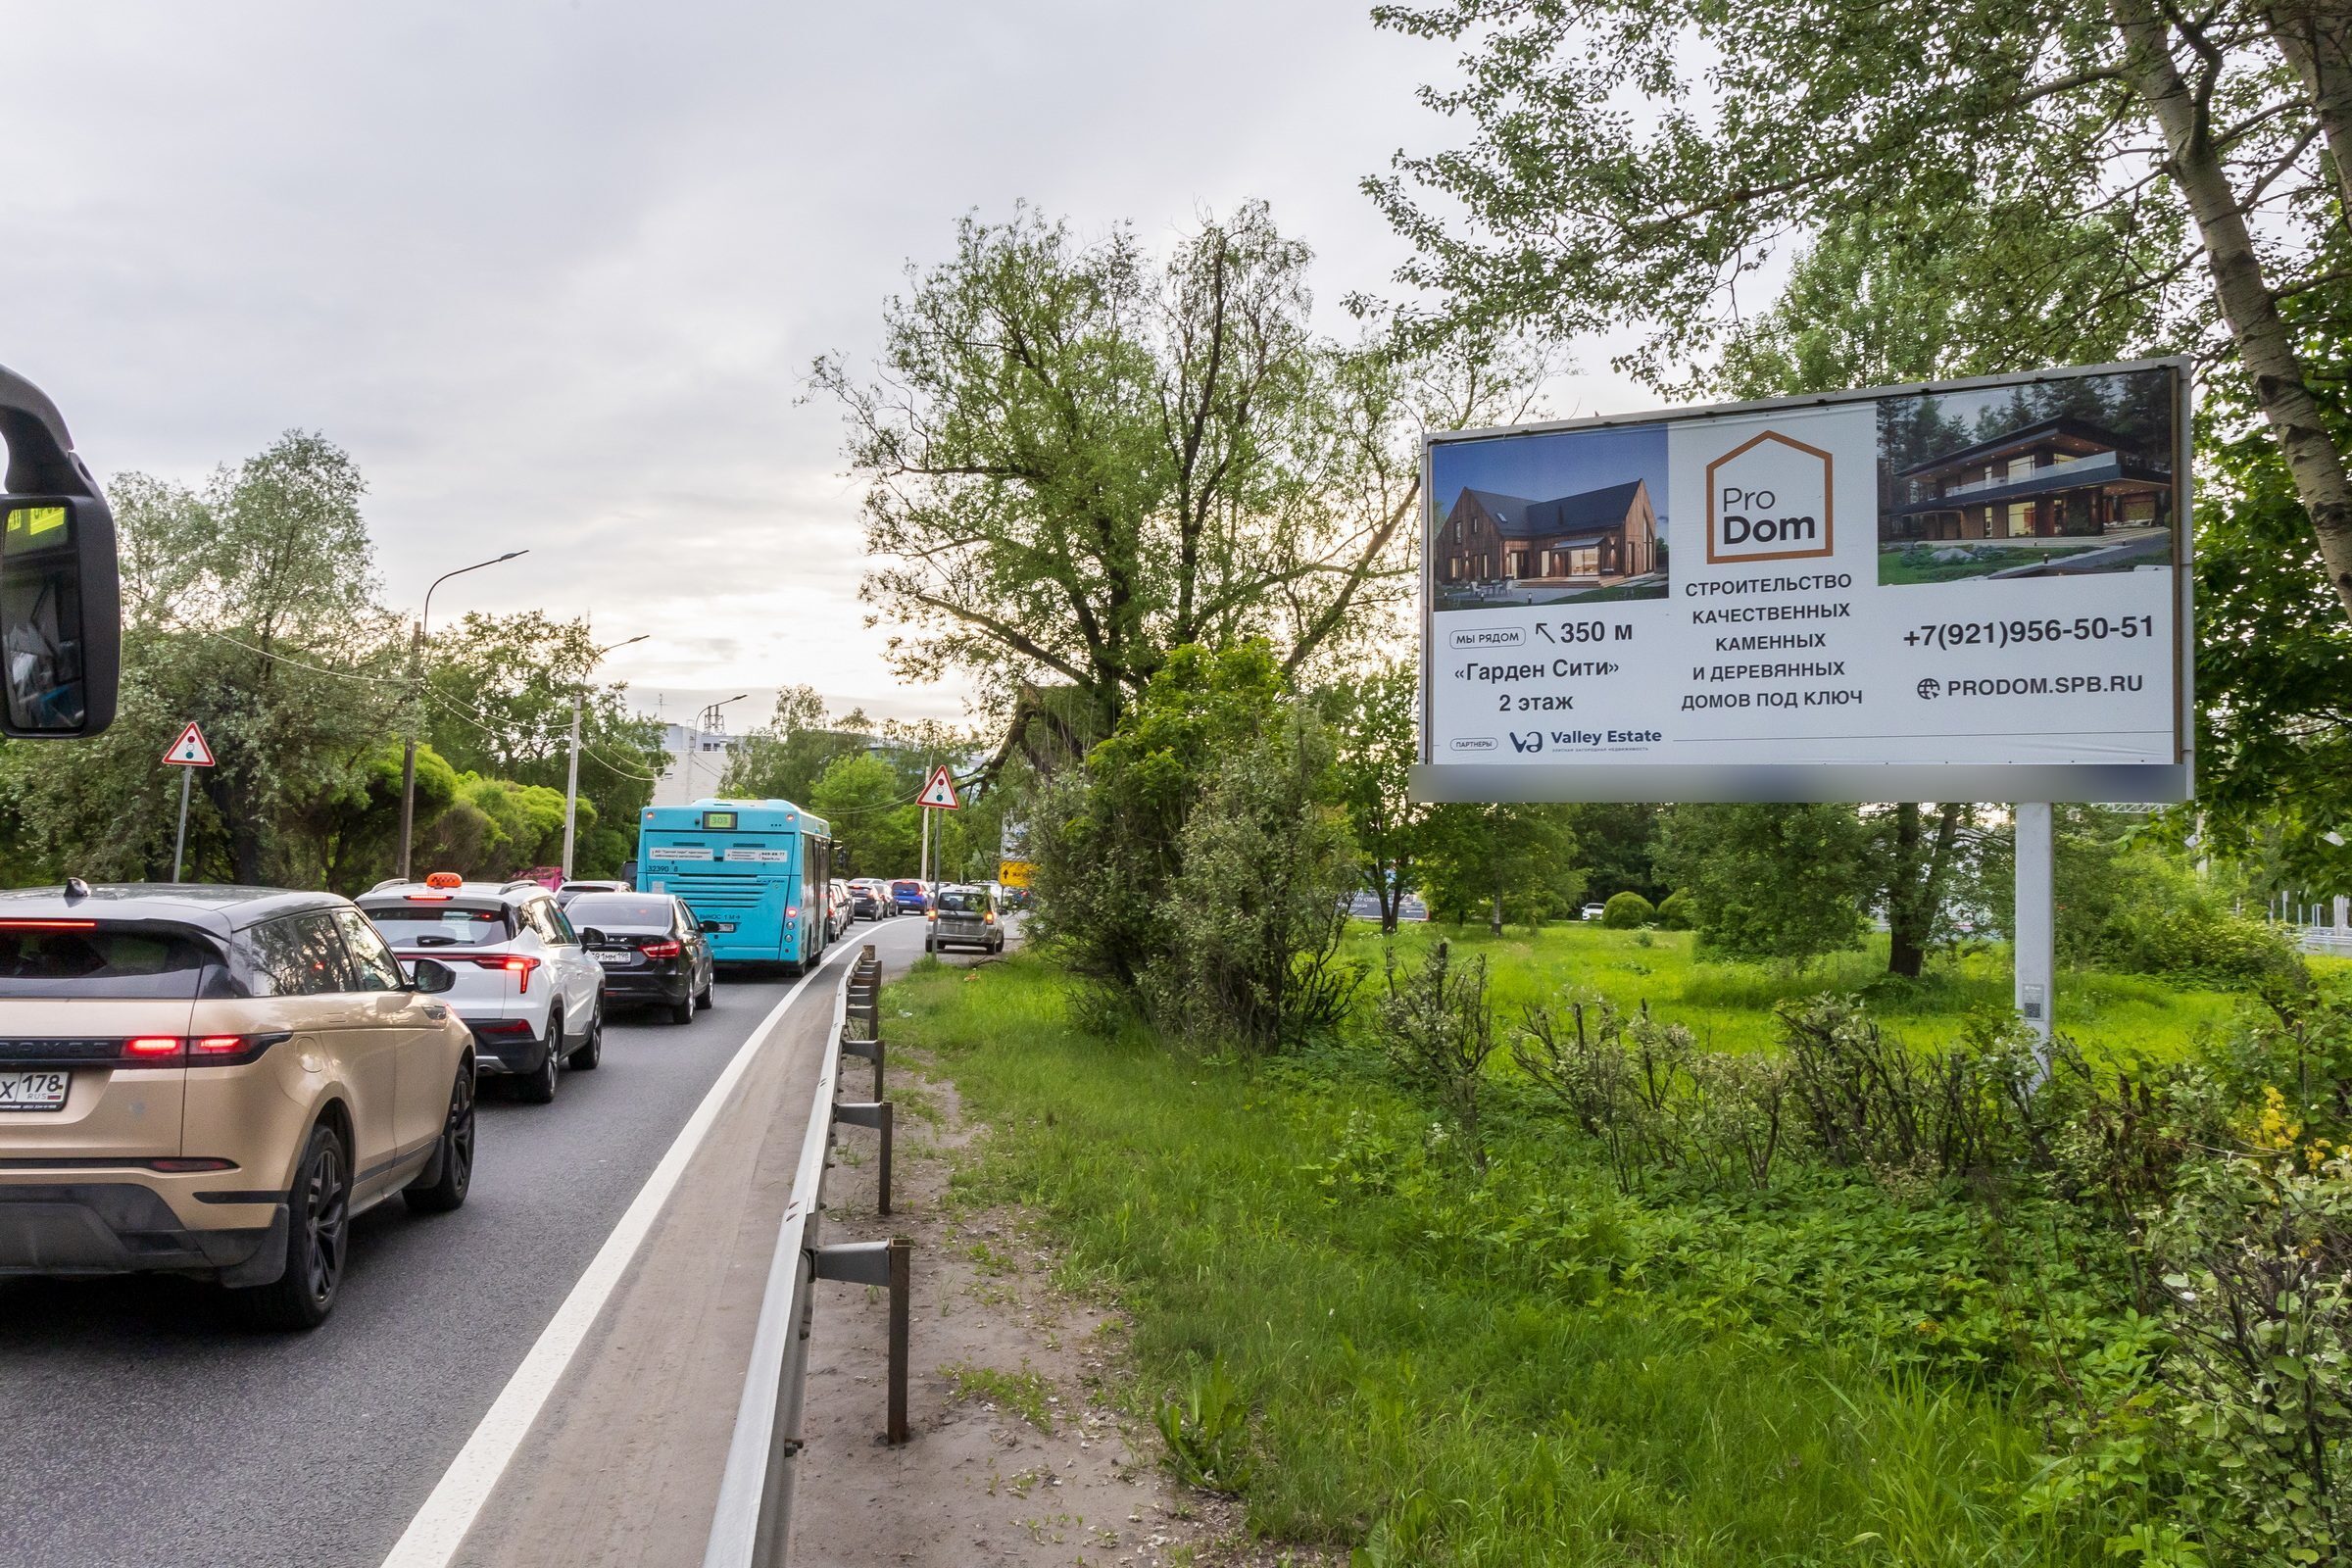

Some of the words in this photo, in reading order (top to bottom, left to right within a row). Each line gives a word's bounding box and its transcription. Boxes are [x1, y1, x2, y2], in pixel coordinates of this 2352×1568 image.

[1723, 487, 1776, 513] Pro
[1723, 515, 1815, 545] Dom
[1686, 573, 1852, 597] СТРОИТЕЛЬСТВО
[1692, 603, 1851, 624] КАЧЕСТВЕННЫХ
[1455, 633, 1476, 645] МЫ
[1478, 632, 1520, 644] РЯДОМ
[1559, 620, 1605, 644] 350
[1614, 623, 1633, 641] м
[1715, 632, 1827, 652] КАМЕННЫХ
[1903, 614, 2154, 651] +7(921)956-50-51
[1454, 662, 1545, 684] «Гарден
[1552, 659, 1620, 679] Сити»
[1692, 666, 1705, 681] И
[1710, 661, 1845, 682] ДЕРЕВЯННЫХ
[1947, 674, 2144, 697] PRODOM.SPB.RU
[1498, 694, 1511, 711] 2
[1518, 695, 1574, 711] этаж
[1681, 693, 1751, 711] ДОМОВ
[1756, 691, 1798, 709] ПОД
[1803, 689, 1863, 707] КЛЮЧ
[1455, 740, 1493, 749] ПАРТНЕРЫ
[1550, 729, 1602, 746] Valley
[1607, 729, 1662, 743] Estate
[23, 1074, 61, 1093] 178
